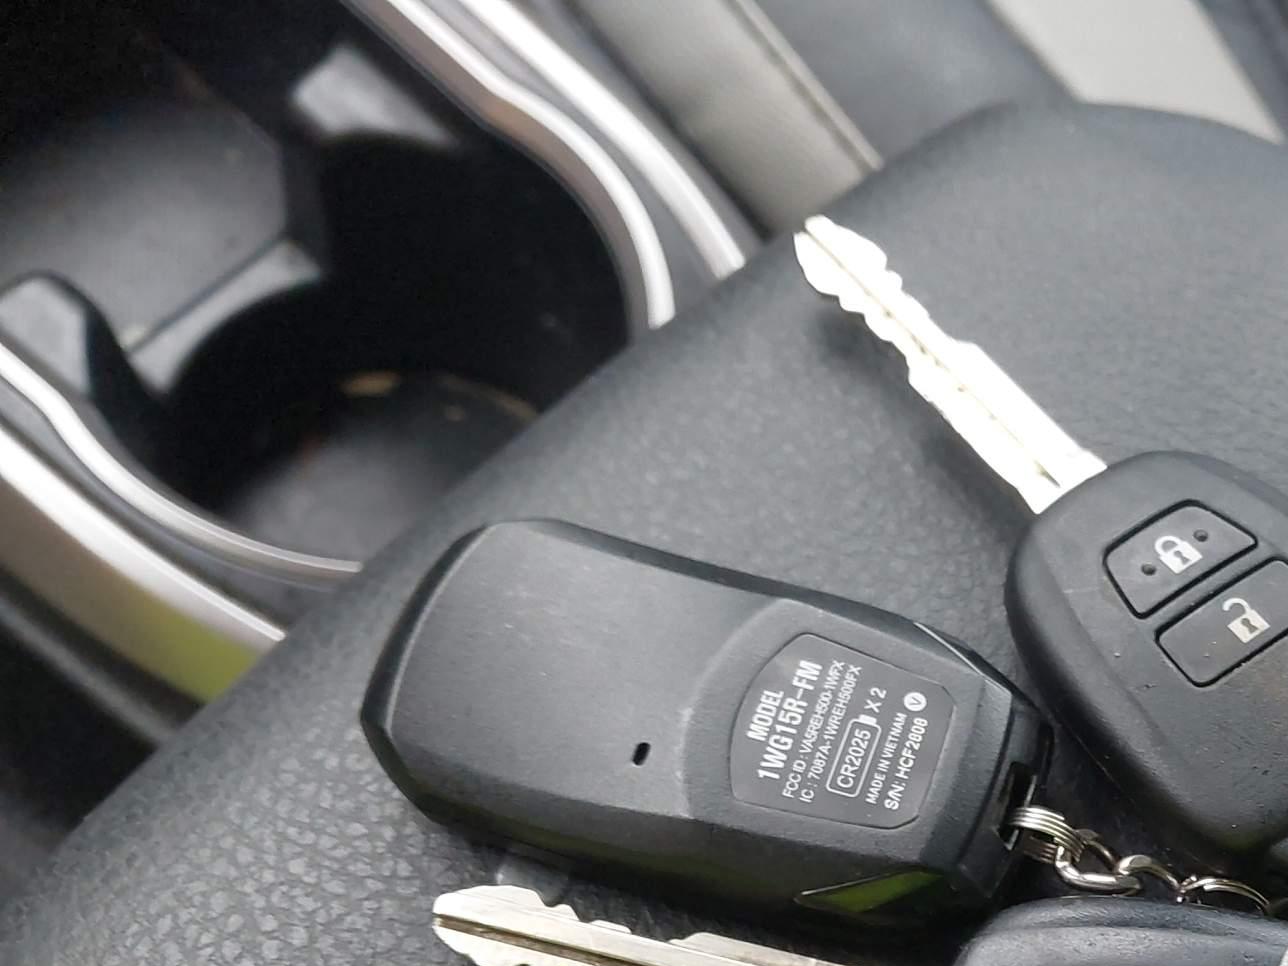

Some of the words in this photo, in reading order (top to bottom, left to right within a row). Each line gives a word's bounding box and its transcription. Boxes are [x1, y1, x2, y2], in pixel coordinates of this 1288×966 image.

[747, 690, 784, 741] MODEL
[757, 660, 823, 779] 1WG15R-FM
[798, 788, 815, 803] IC
[807, 664, 862, 780] 7087A-1WREH500FX
[837, 728, 871, 788] CR2025
[870, 687, 887, 699] 2
[881, 712, 907, 758] VIETNAM
[781, 772, 801, 798] FCC
[792, 759, 807, 773] ID
[865, 772, 886, 804] MADE
[877, 759, 891, 772] IN
[884, 780, 906, 810] S/N:
